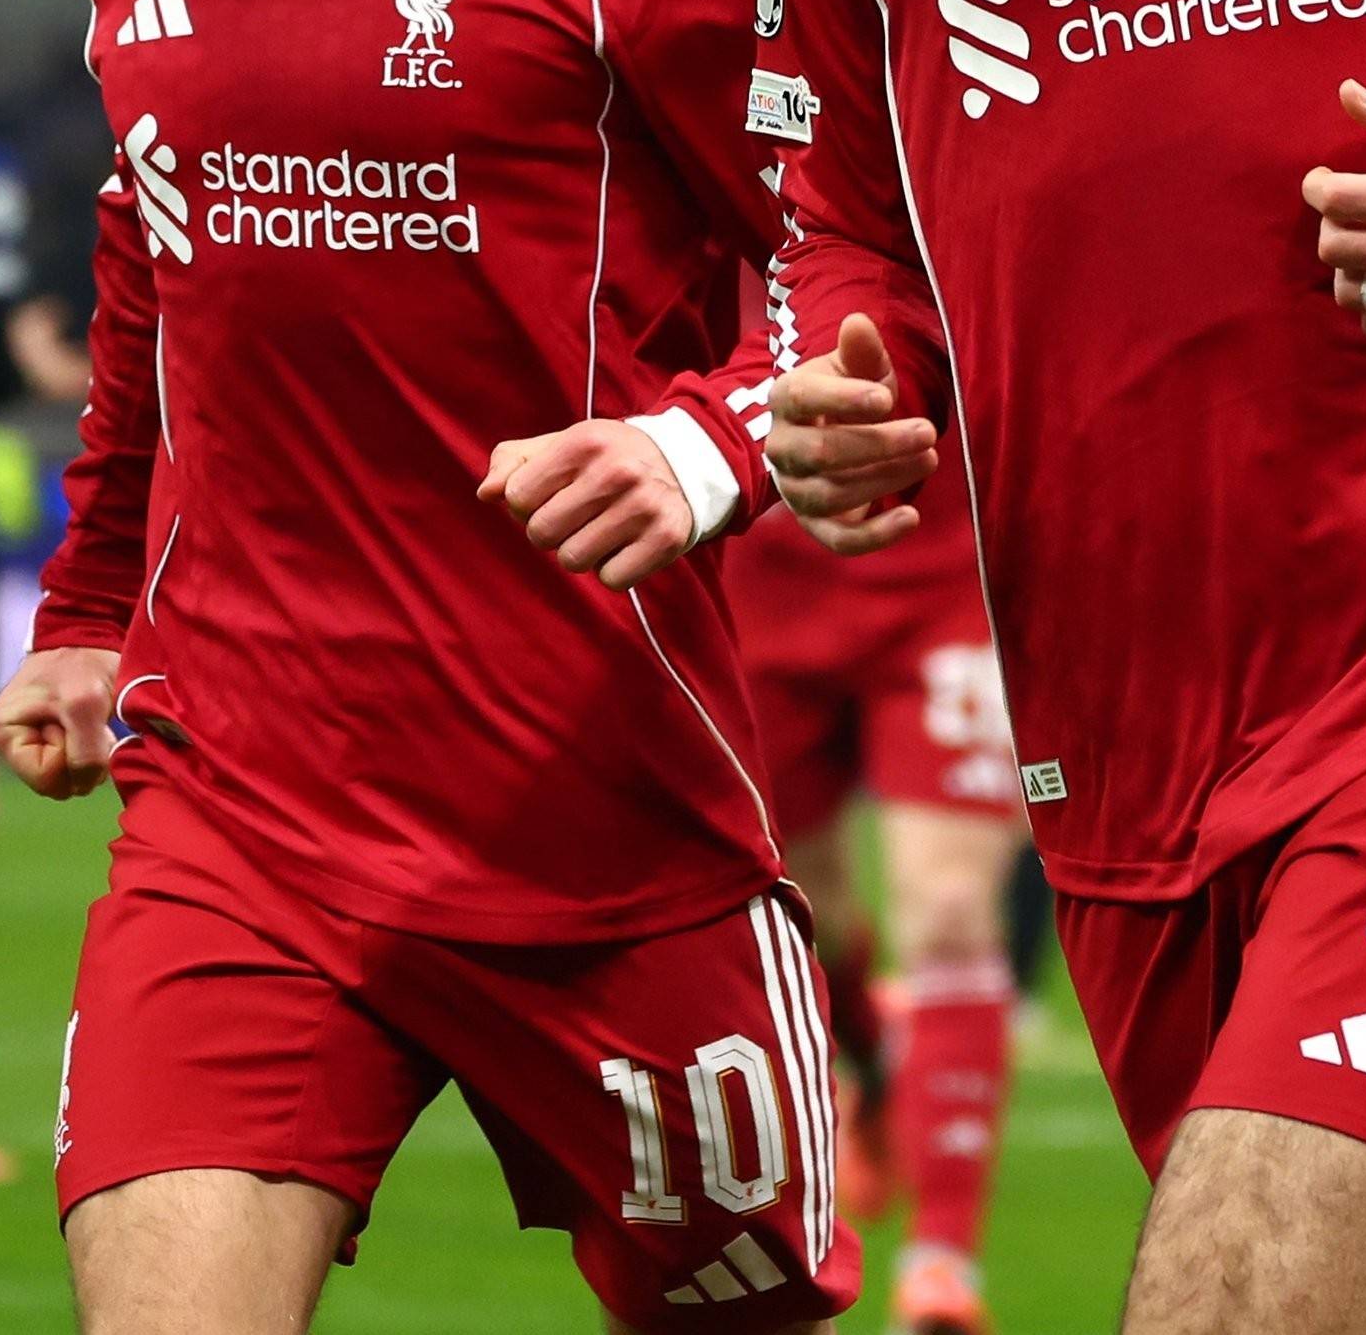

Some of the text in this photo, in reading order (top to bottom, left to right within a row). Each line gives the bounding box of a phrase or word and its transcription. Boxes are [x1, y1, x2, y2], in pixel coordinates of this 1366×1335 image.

[382, 57, 463, 89] L.F.C.
[201, 142, 457, 202] standard
[207, 195, 480, 253] chartered
[601, 1032, 790, 1225] 10
